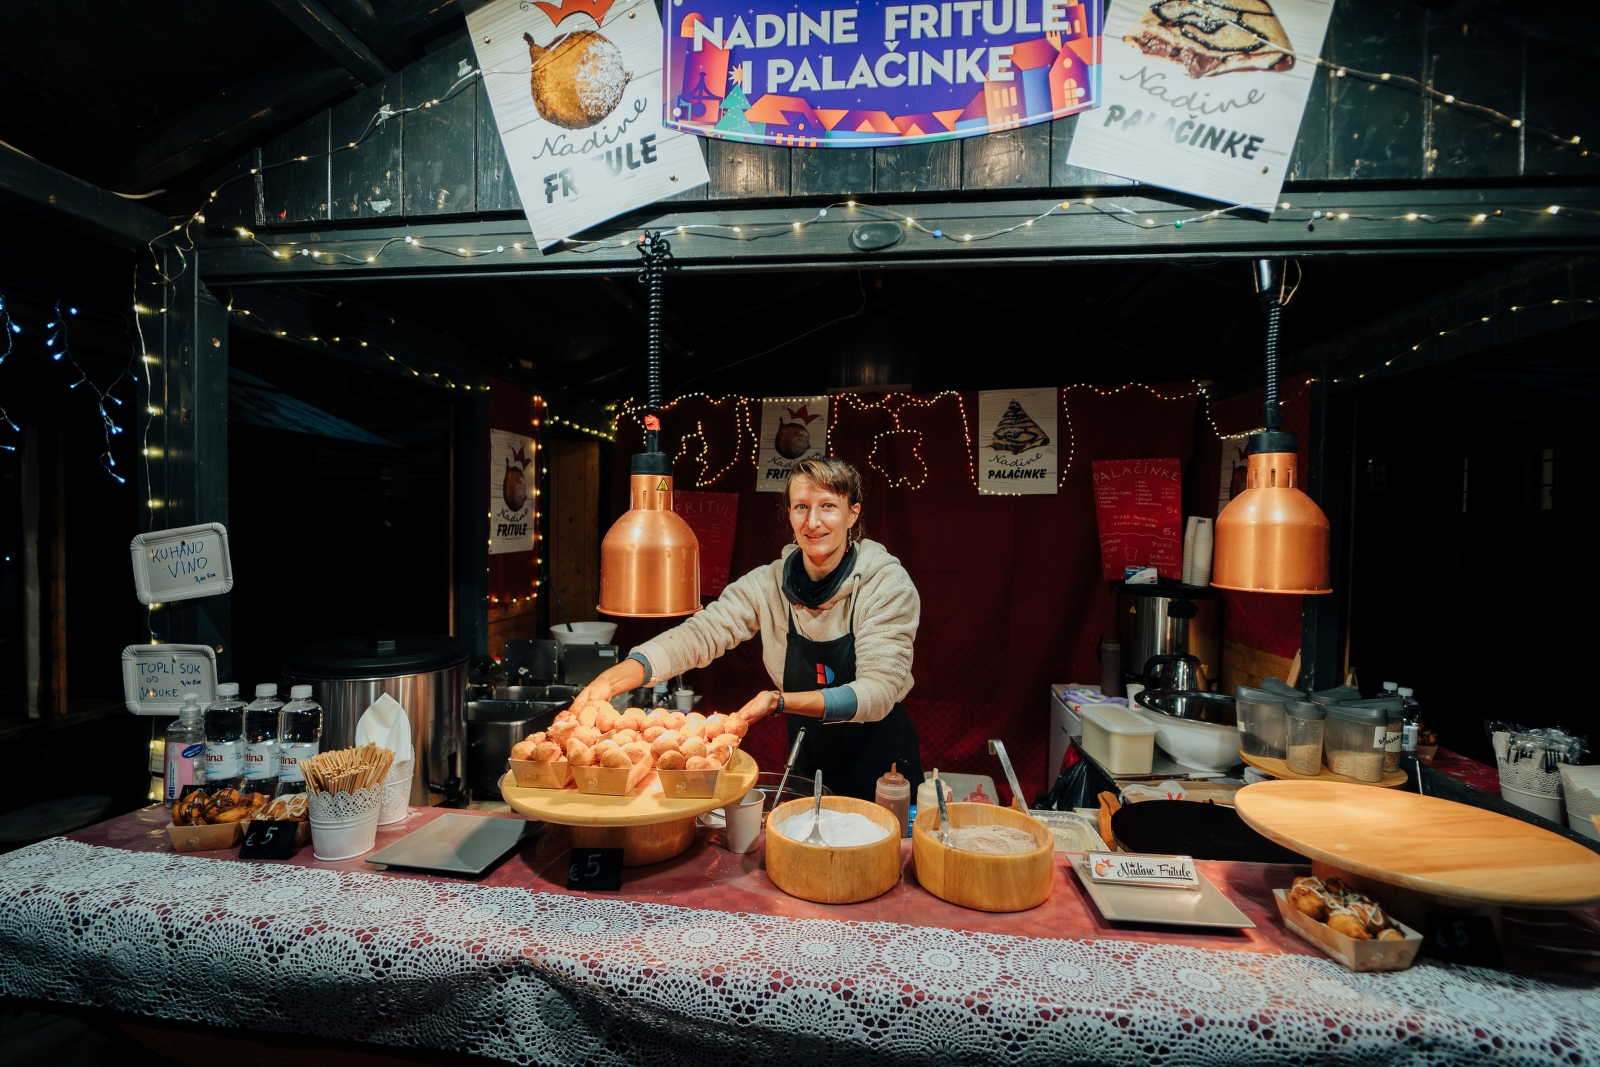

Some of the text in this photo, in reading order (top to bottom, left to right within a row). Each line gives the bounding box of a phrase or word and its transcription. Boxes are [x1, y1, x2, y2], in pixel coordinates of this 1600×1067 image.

[693, 0, 1069, 51] NADINE FRITULE
[742, 41, 1015, 94] I PALAČINKE
[1119, 65, 1266, 115] Nadine
[532, 97, 647, 160] Nadine
[543, 133, 658, 203] FRULE
[767, 456, 797, 468] Nadi
[989, 453, 1042, 467] Nadine
[766, 469, 792, 479] FRIT
[987, 467, 1047, 479] PALAČINKE
[497, 507, 528, 522] Nadine
[497, 523, 528, 537] FRITULE
[151, 541, 204, 563] KUHANO
[167, 557, 208, 578] VINO
[136, 662, 201, 675] TOPLI SOK
[139, 686, 178, 700] JABUKE
[204, 753, 223, 762] tina
[279, 755, 297, 765] tina
[245, 827, 278, 847] € 5
[584, 854, 601, 878] 5
[1117, 861, 1192, 878] Nadine Fritule
[1453, 922, 1468, 947] 5
